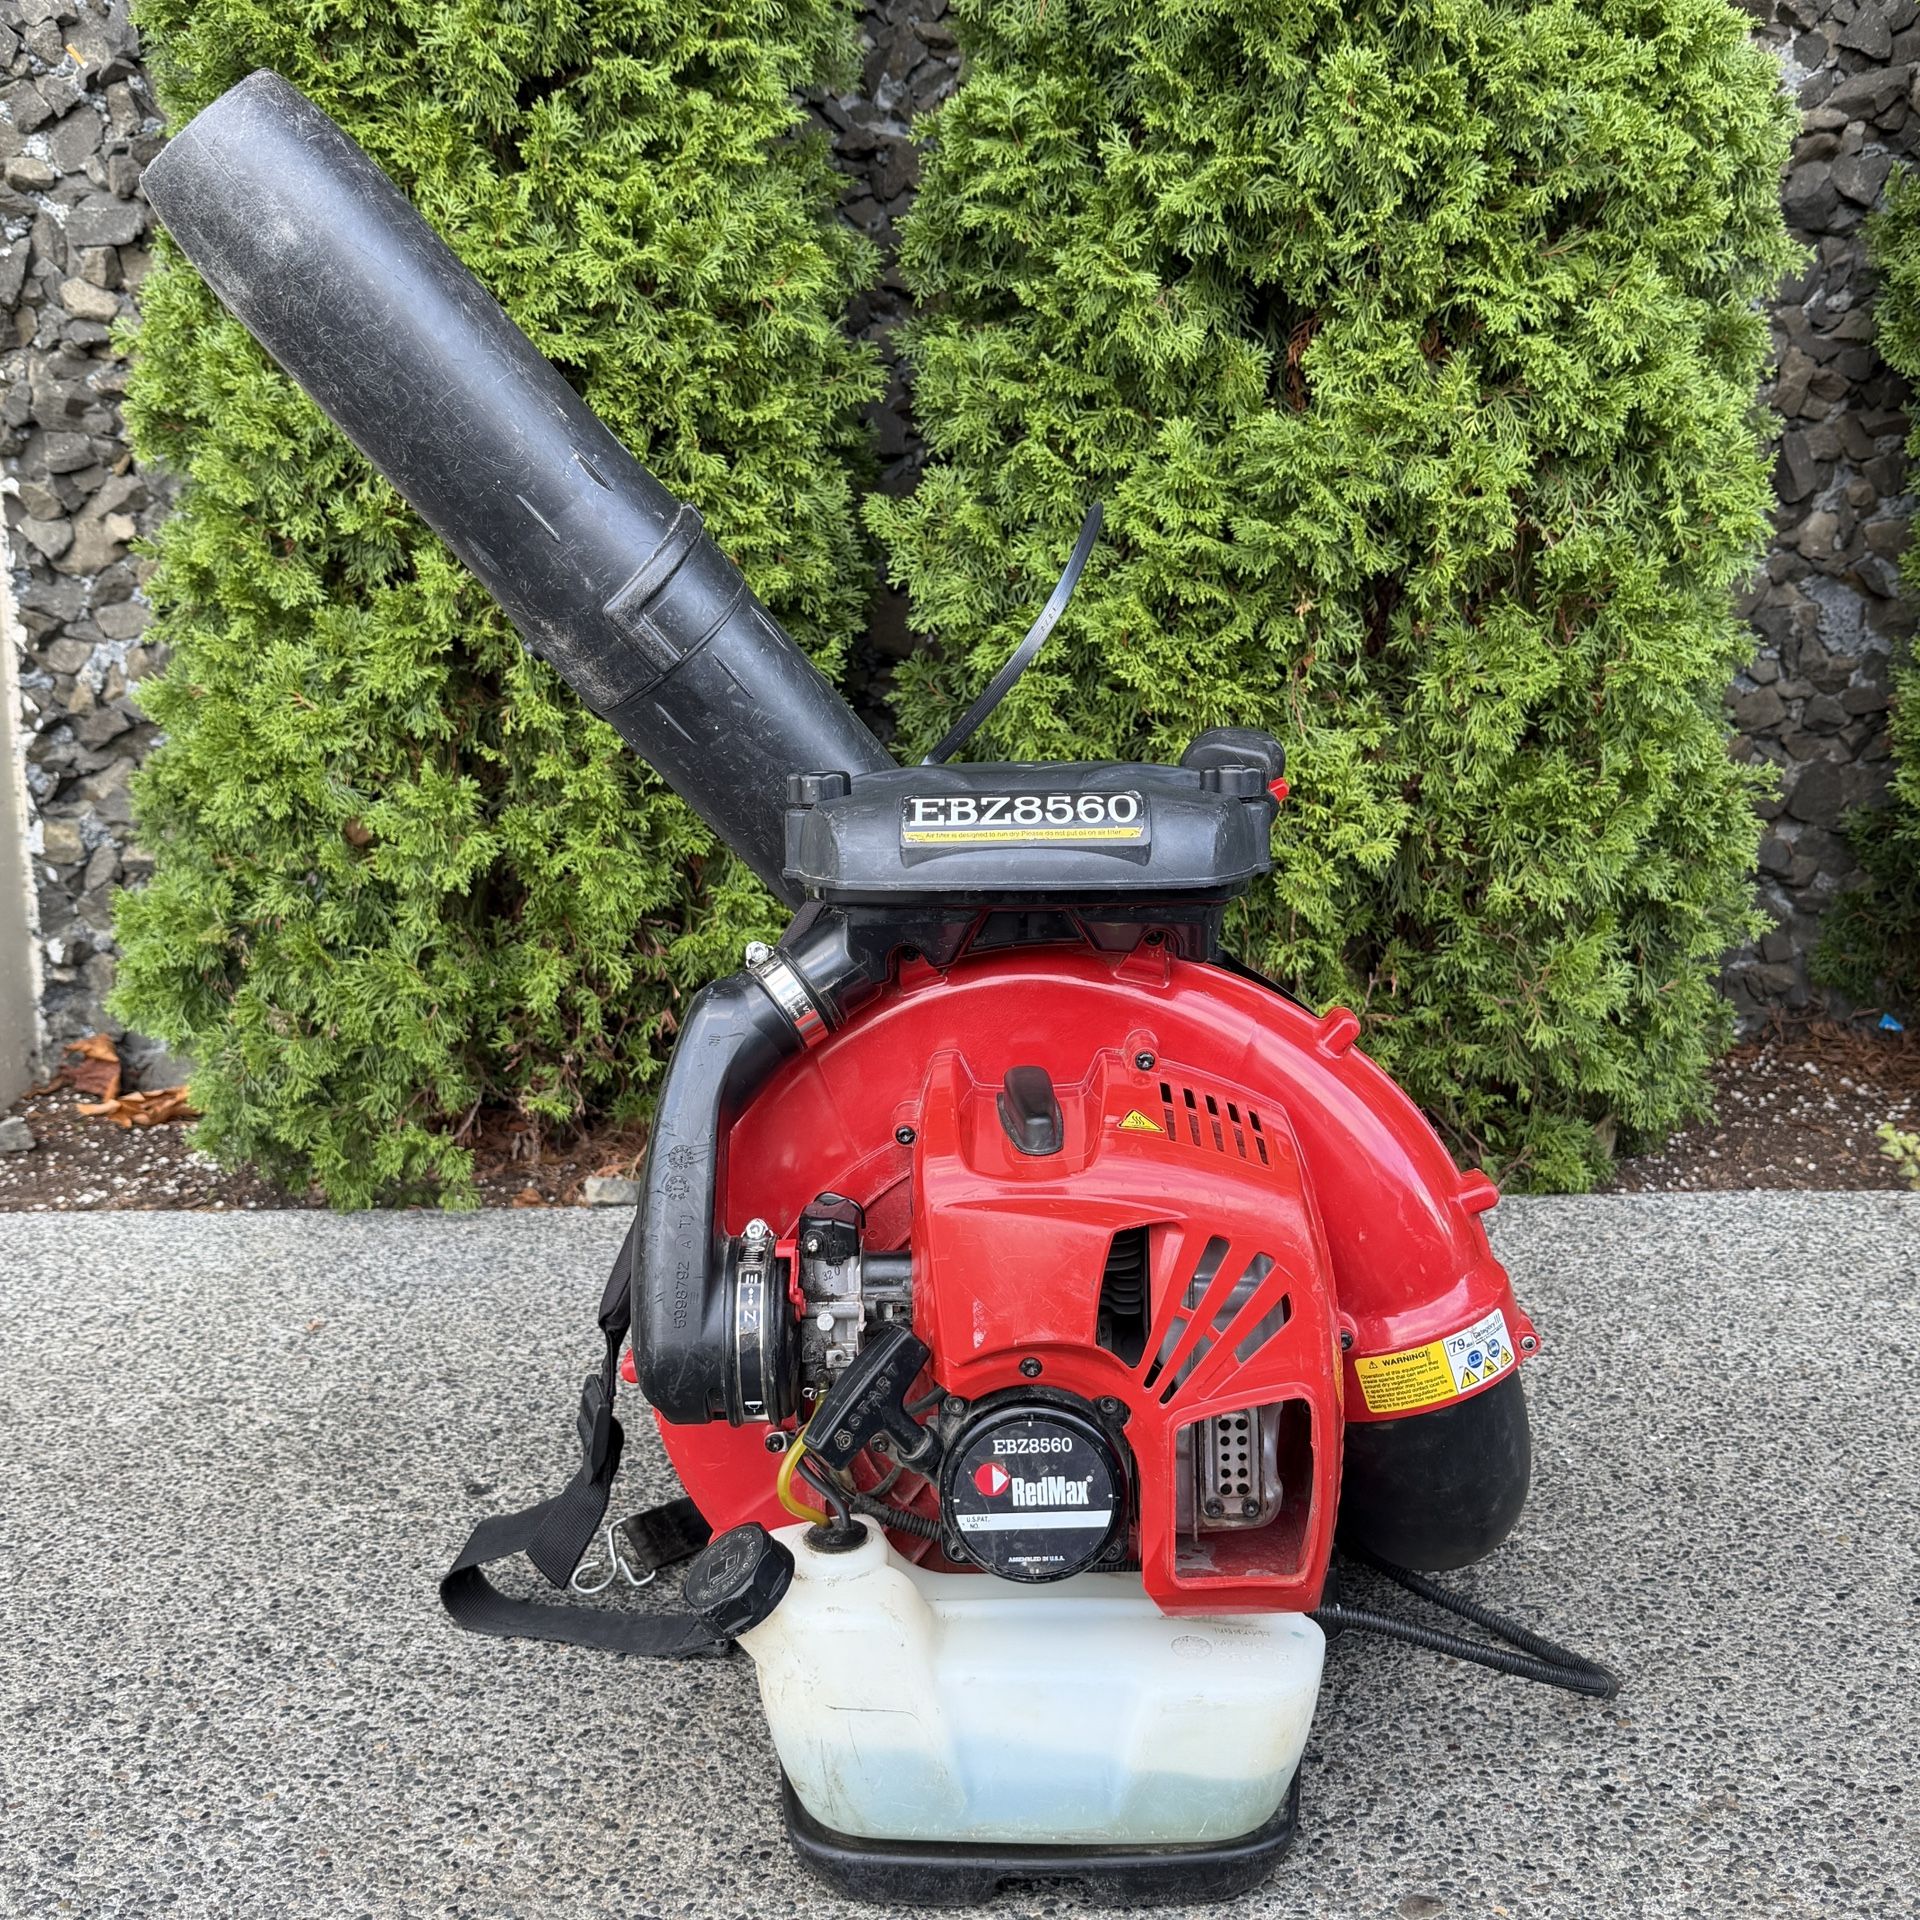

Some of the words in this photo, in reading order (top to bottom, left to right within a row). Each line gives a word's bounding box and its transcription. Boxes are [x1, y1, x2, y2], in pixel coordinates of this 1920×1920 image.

[909, 795, 1138, 827] EBZ8560
[1449, 1338, 1466, 1353] 79
[1382, 1350, 1428, 1367] WARNING!
[849, 1362, 899, 1430] START
[993, 1437, 1073, 1455] EBZ8560
[1011, 1475, 1090, 1507] RedMax
